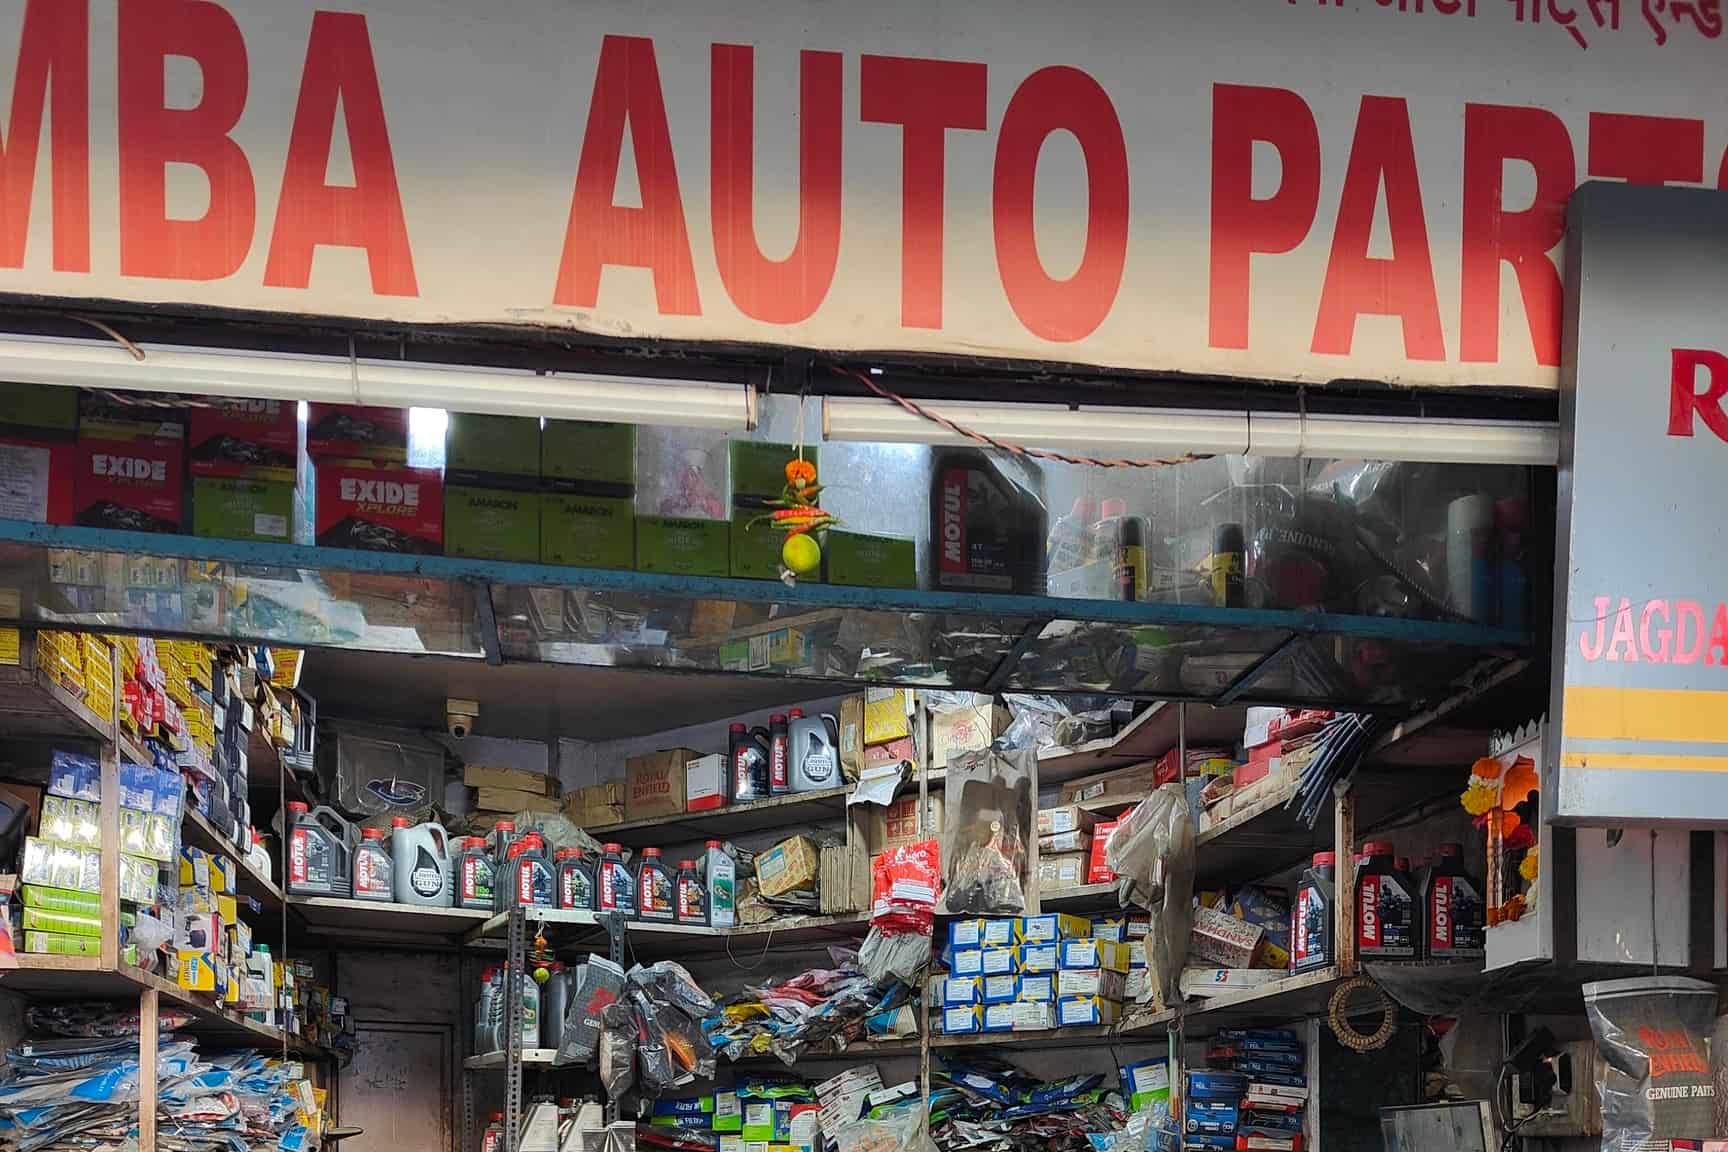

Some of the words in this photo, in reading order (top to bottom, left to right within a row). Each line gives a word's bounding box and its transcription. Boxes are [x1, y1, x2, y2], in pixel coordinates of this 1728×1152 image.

[0, 0, 419, 298] MBA
[553, 34, 1130, 343] AUTO
[1208, 82, 1728, 368] PAR
[93, 454, 167, 482] EXIDE
[340, 478, 420, 506] EXIDE
[944, 483, 961, 563] MOTUL
[774, 739, 785, 782] MOTUL
[294, 838, 304, 878] MOTUL
[359, 849, 370, 888] MOTUL
[465, 861, 475, 896] MOTUL
[521, 865, 531, 900] MOTUL
[563, 871, 572, 904] MOTUL
[602, 868, 612, 904] MOTUL
[643, 871, 652, 907] MOTUL
[680, 883, 688, 913] MOTUL
[1363, 883, 1376, 940] MOTUL
[1436, 885, 1448, 942] MOTUL
[1298, 897, 1306, 952] MOTUL
[1646, 1086, 1689, 1100] GENUINE
